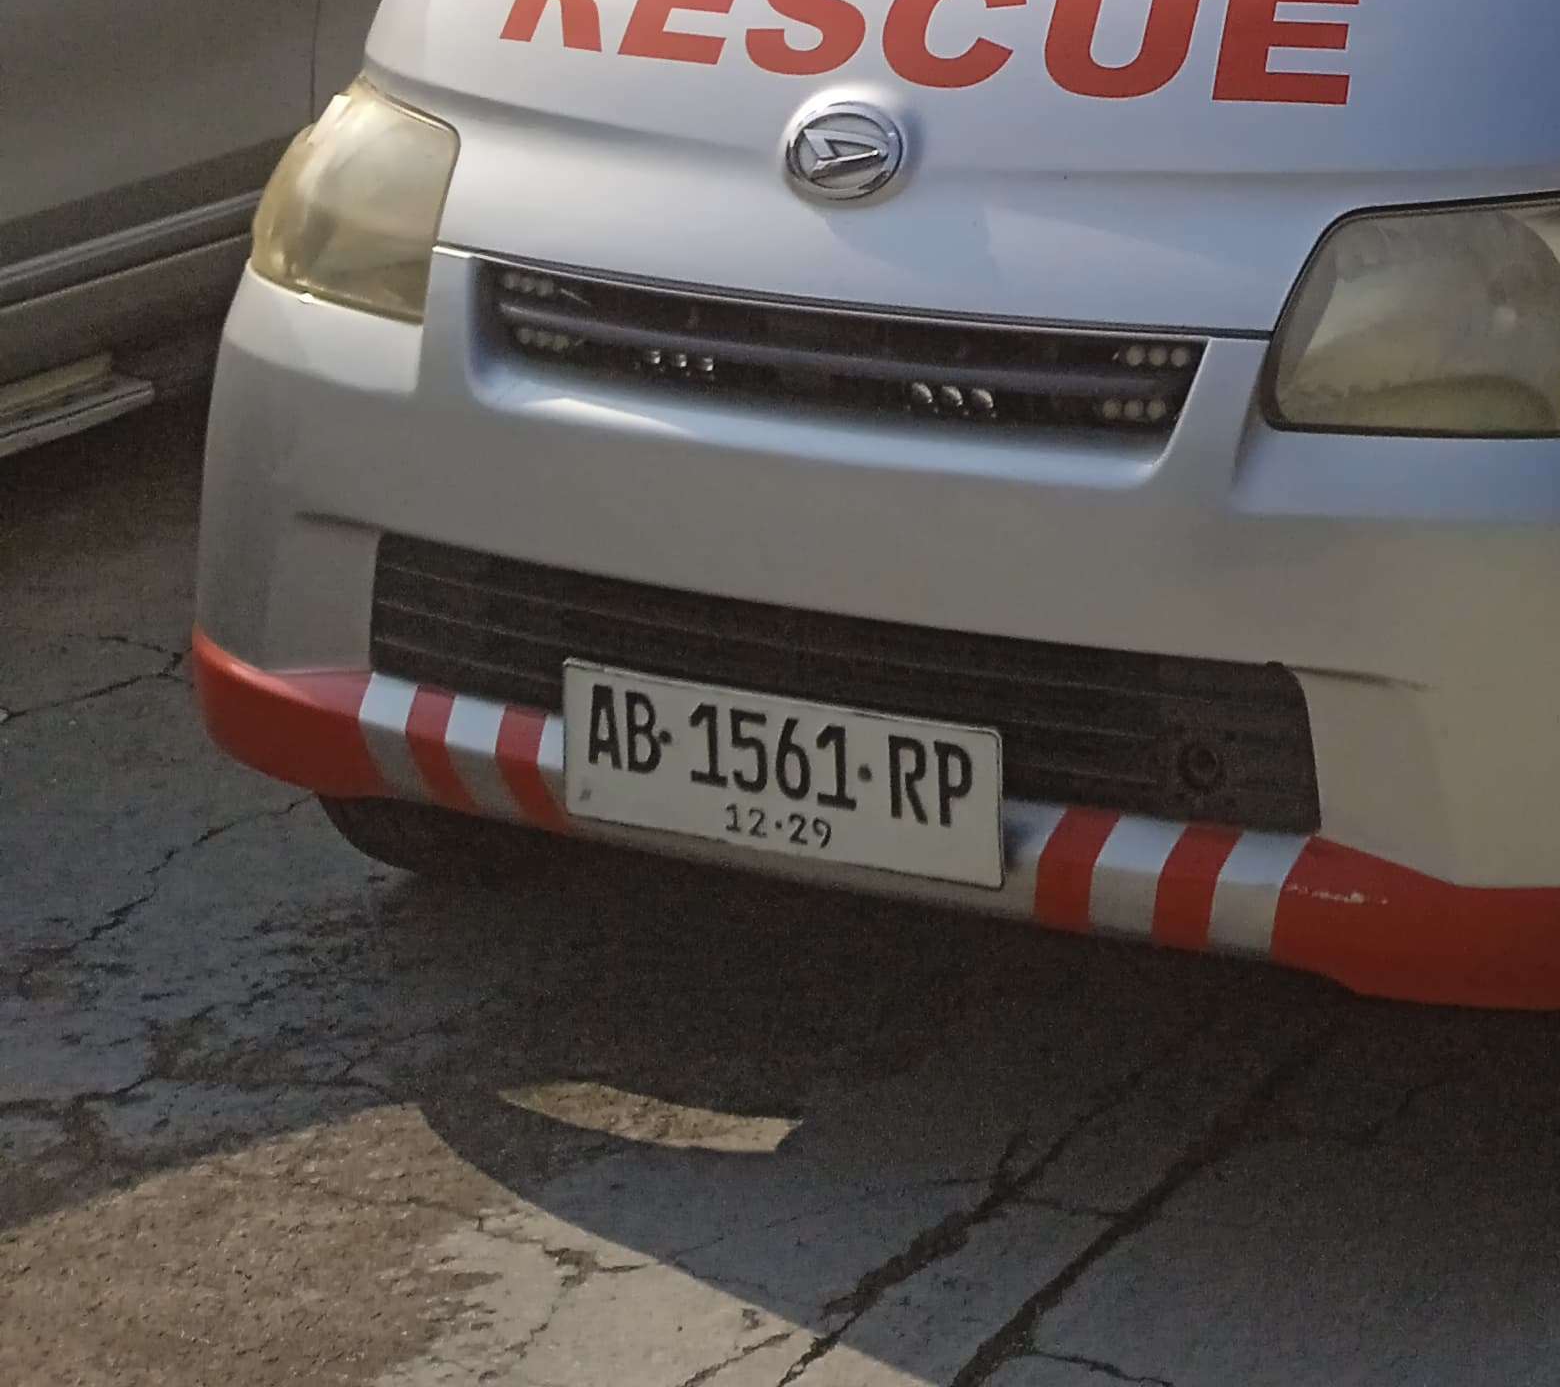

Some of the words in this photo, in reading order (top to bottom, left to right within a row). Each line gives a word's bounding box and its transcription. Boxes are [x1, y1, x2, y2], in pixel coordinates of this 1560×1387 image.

[587, 683, 663, 775] AB
[689, 702, 858, 811] 1561
[887, 733, 974, 827] RP
